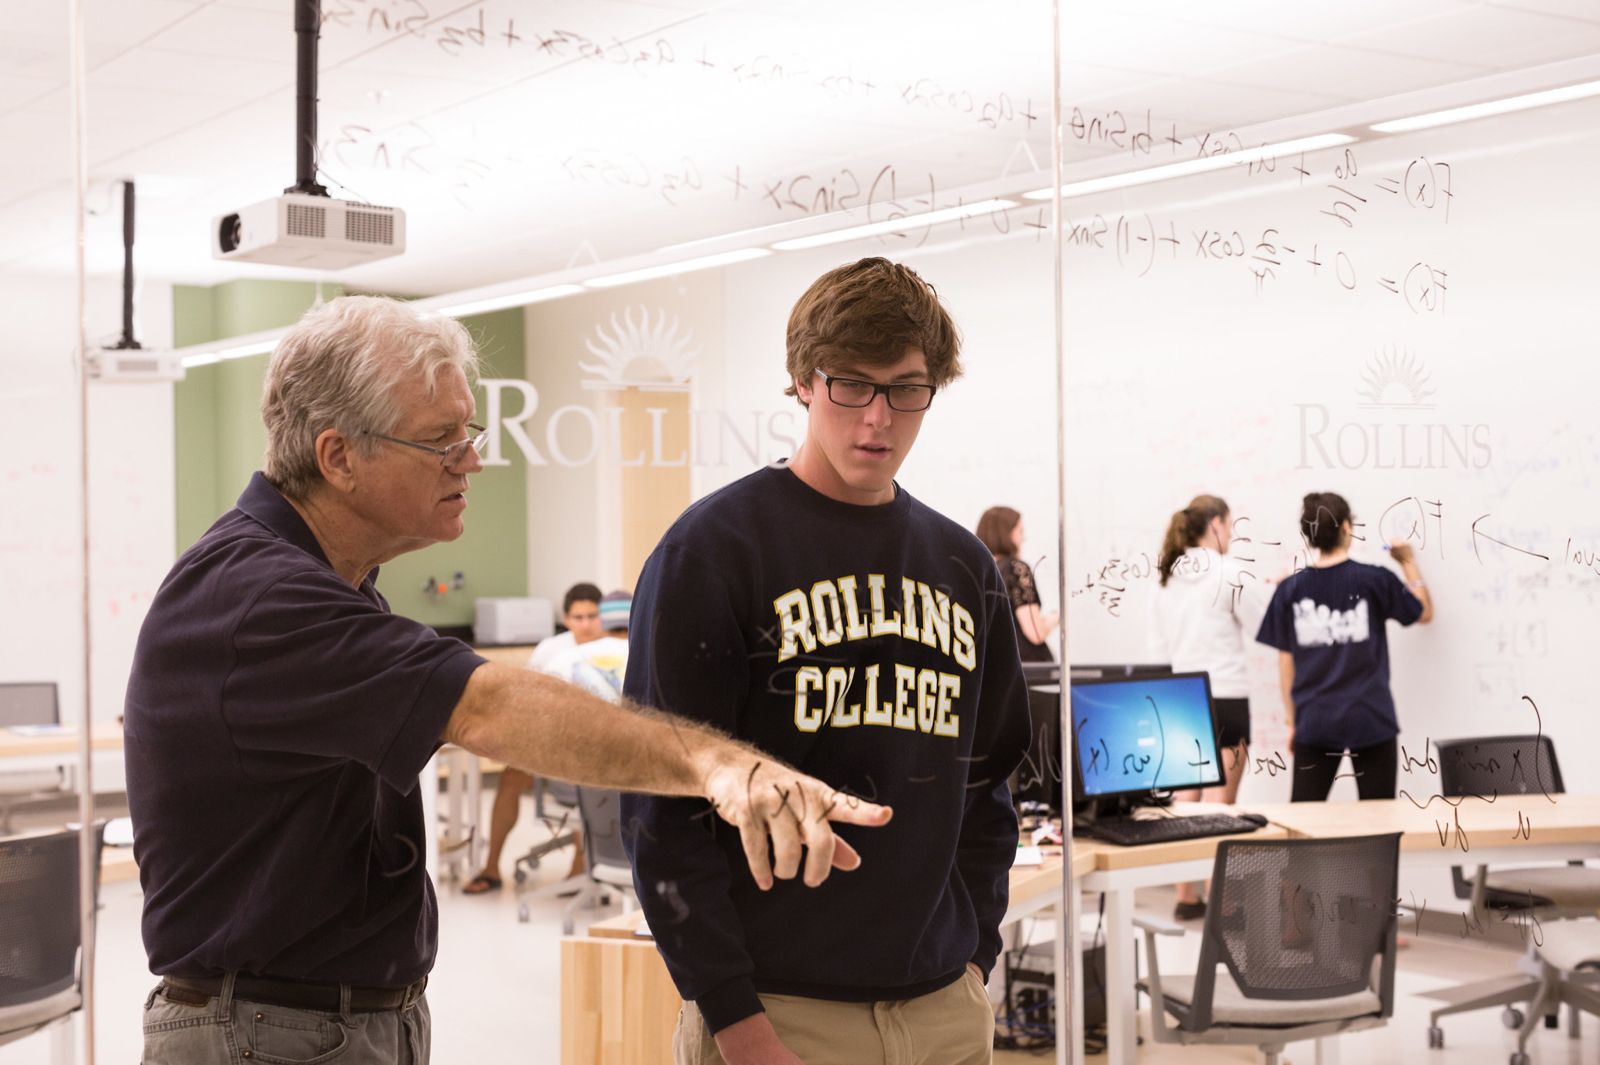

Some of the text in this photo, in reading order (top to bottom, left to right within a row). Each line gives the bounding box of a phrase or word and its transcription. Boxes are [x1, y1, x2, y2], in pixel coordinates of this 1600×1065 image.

[1292, 402, 1493, 470] ROLLINS
[773, 573, 977, 673] ROLLINS
[793, 663, 961, 738] COLLEGE
